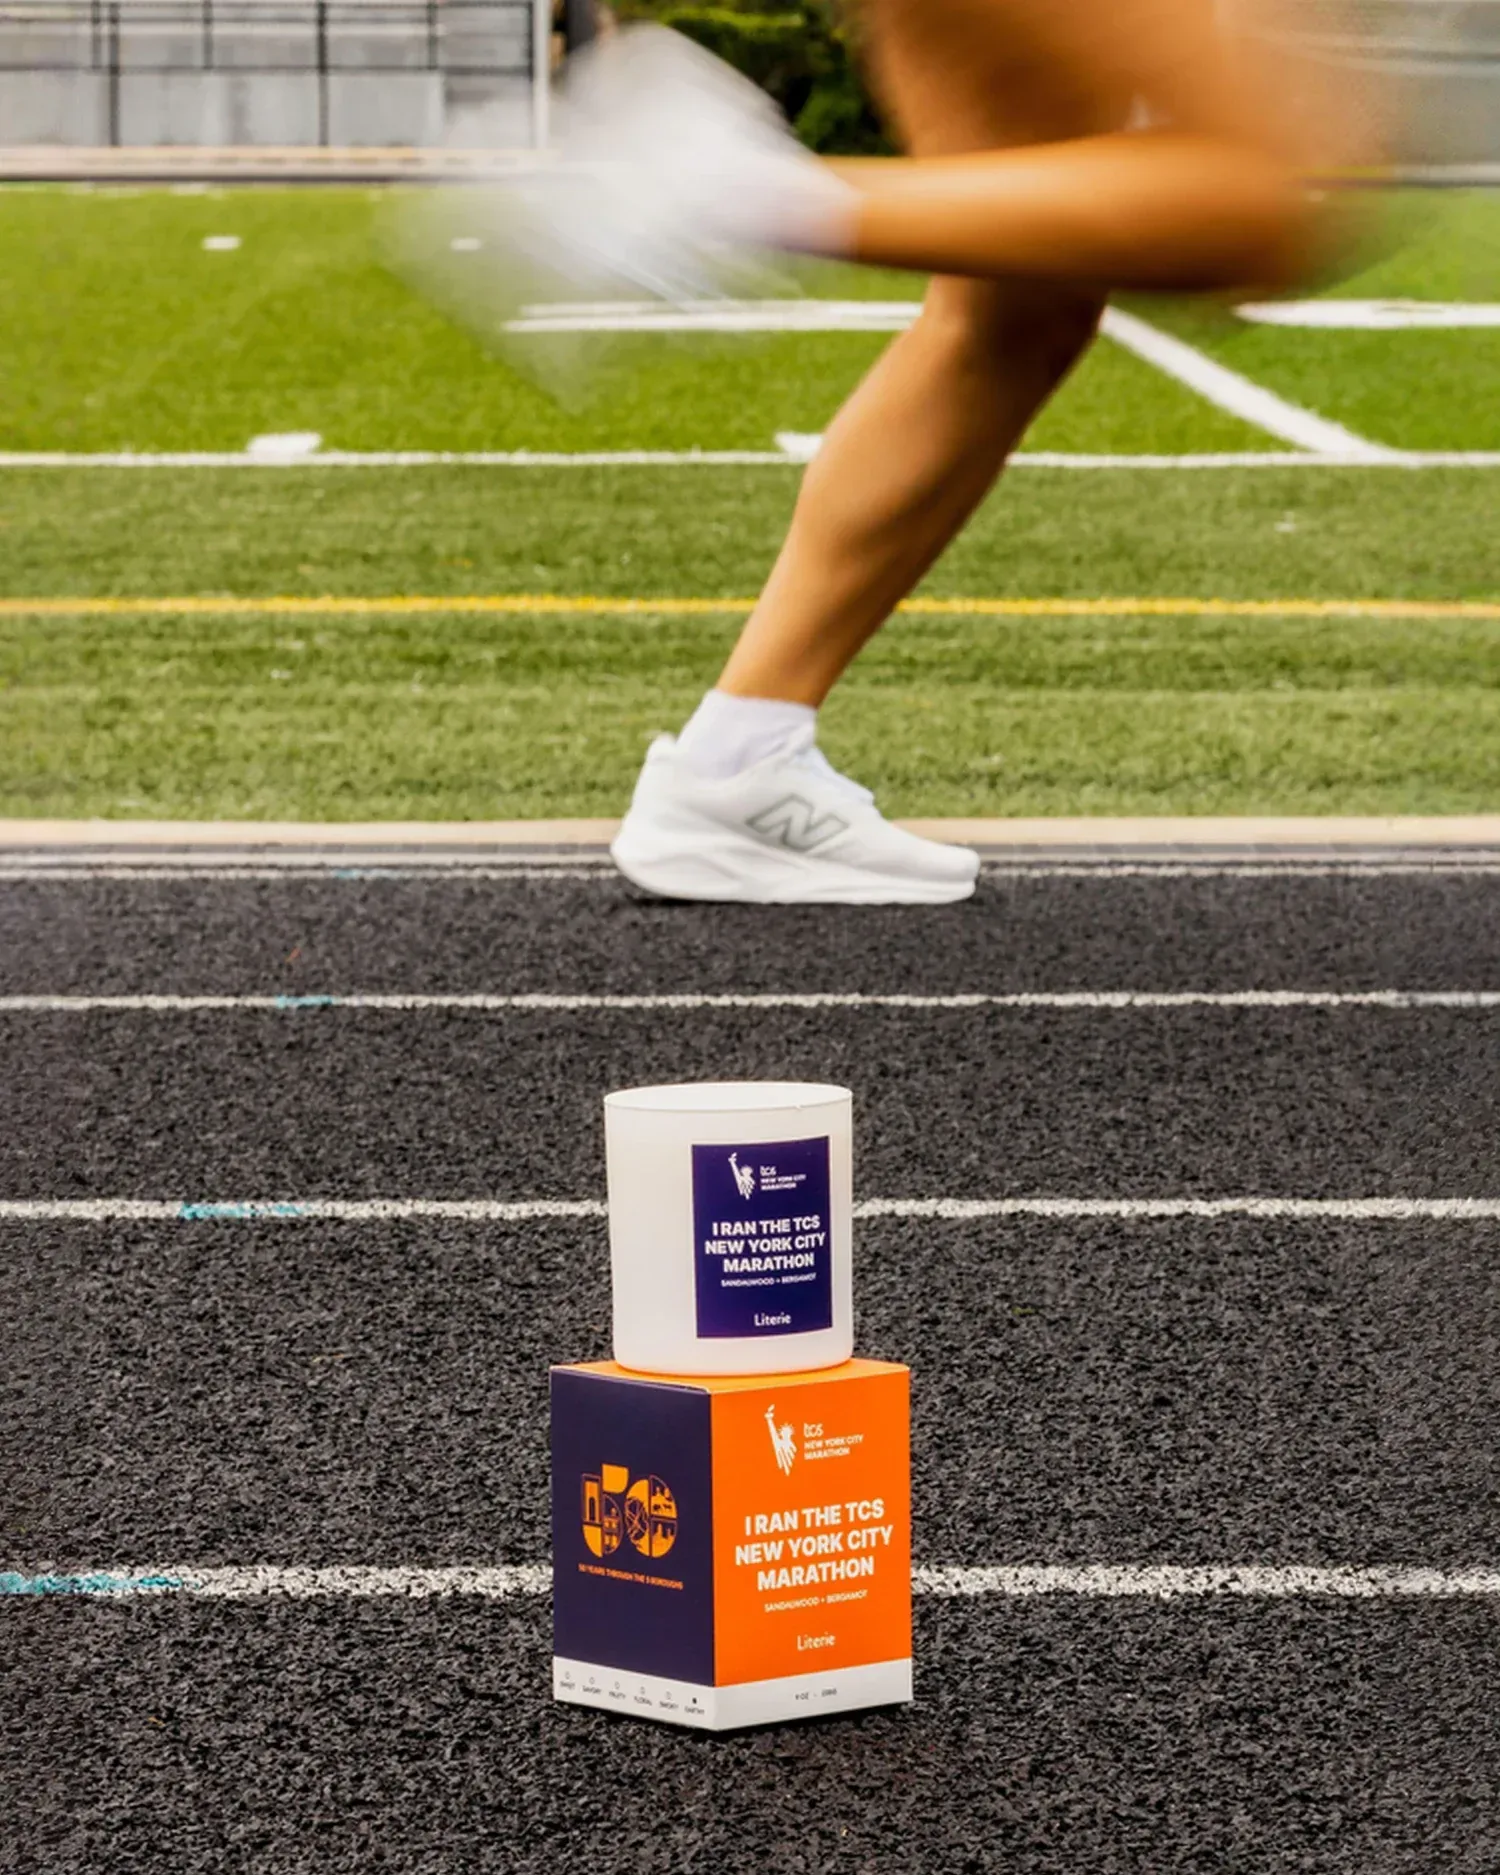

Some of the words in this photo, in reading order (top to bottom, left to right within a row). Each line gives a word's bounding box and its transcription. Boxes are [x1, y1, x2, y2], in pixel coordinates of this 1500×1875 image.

[712, 1222, 718, 1236] I
[721, 1220, 757, 1236] RAN
[759, 1218, 791, 1234] THE
[792, 1215, 821, 1231] TCS
[705, 1240, 744, 1254] NEW
[748, 1238, 792, 1253] YORK
[794, 1232, 826, 1249] CITY
[723, 1252, 815, 1273] MARATHON
[754, 1311, 792, 1326] Literie
[804, 1440, 823, 1450] NEW
[825, 1437, 845, 1447] YORK
[846, 1434, 864, 1445] CITY
[804, 1447, 850, 1460] MARATHON
[745, 1516, 751, 1536] I
[755, 1511, 798, 1535] RAN
[802, 1505, 842, 1529] THE
[845, 1498, 885, 1522] TCS
[735, 1540, 784, 1566] NEW
[787, 1532, 844, 1558] YORK
[847, 1525, 894, 1550] CITY
[757, 1556, 875, 1591] MARATHON
[797, 1631, 836, 1651] Literie
